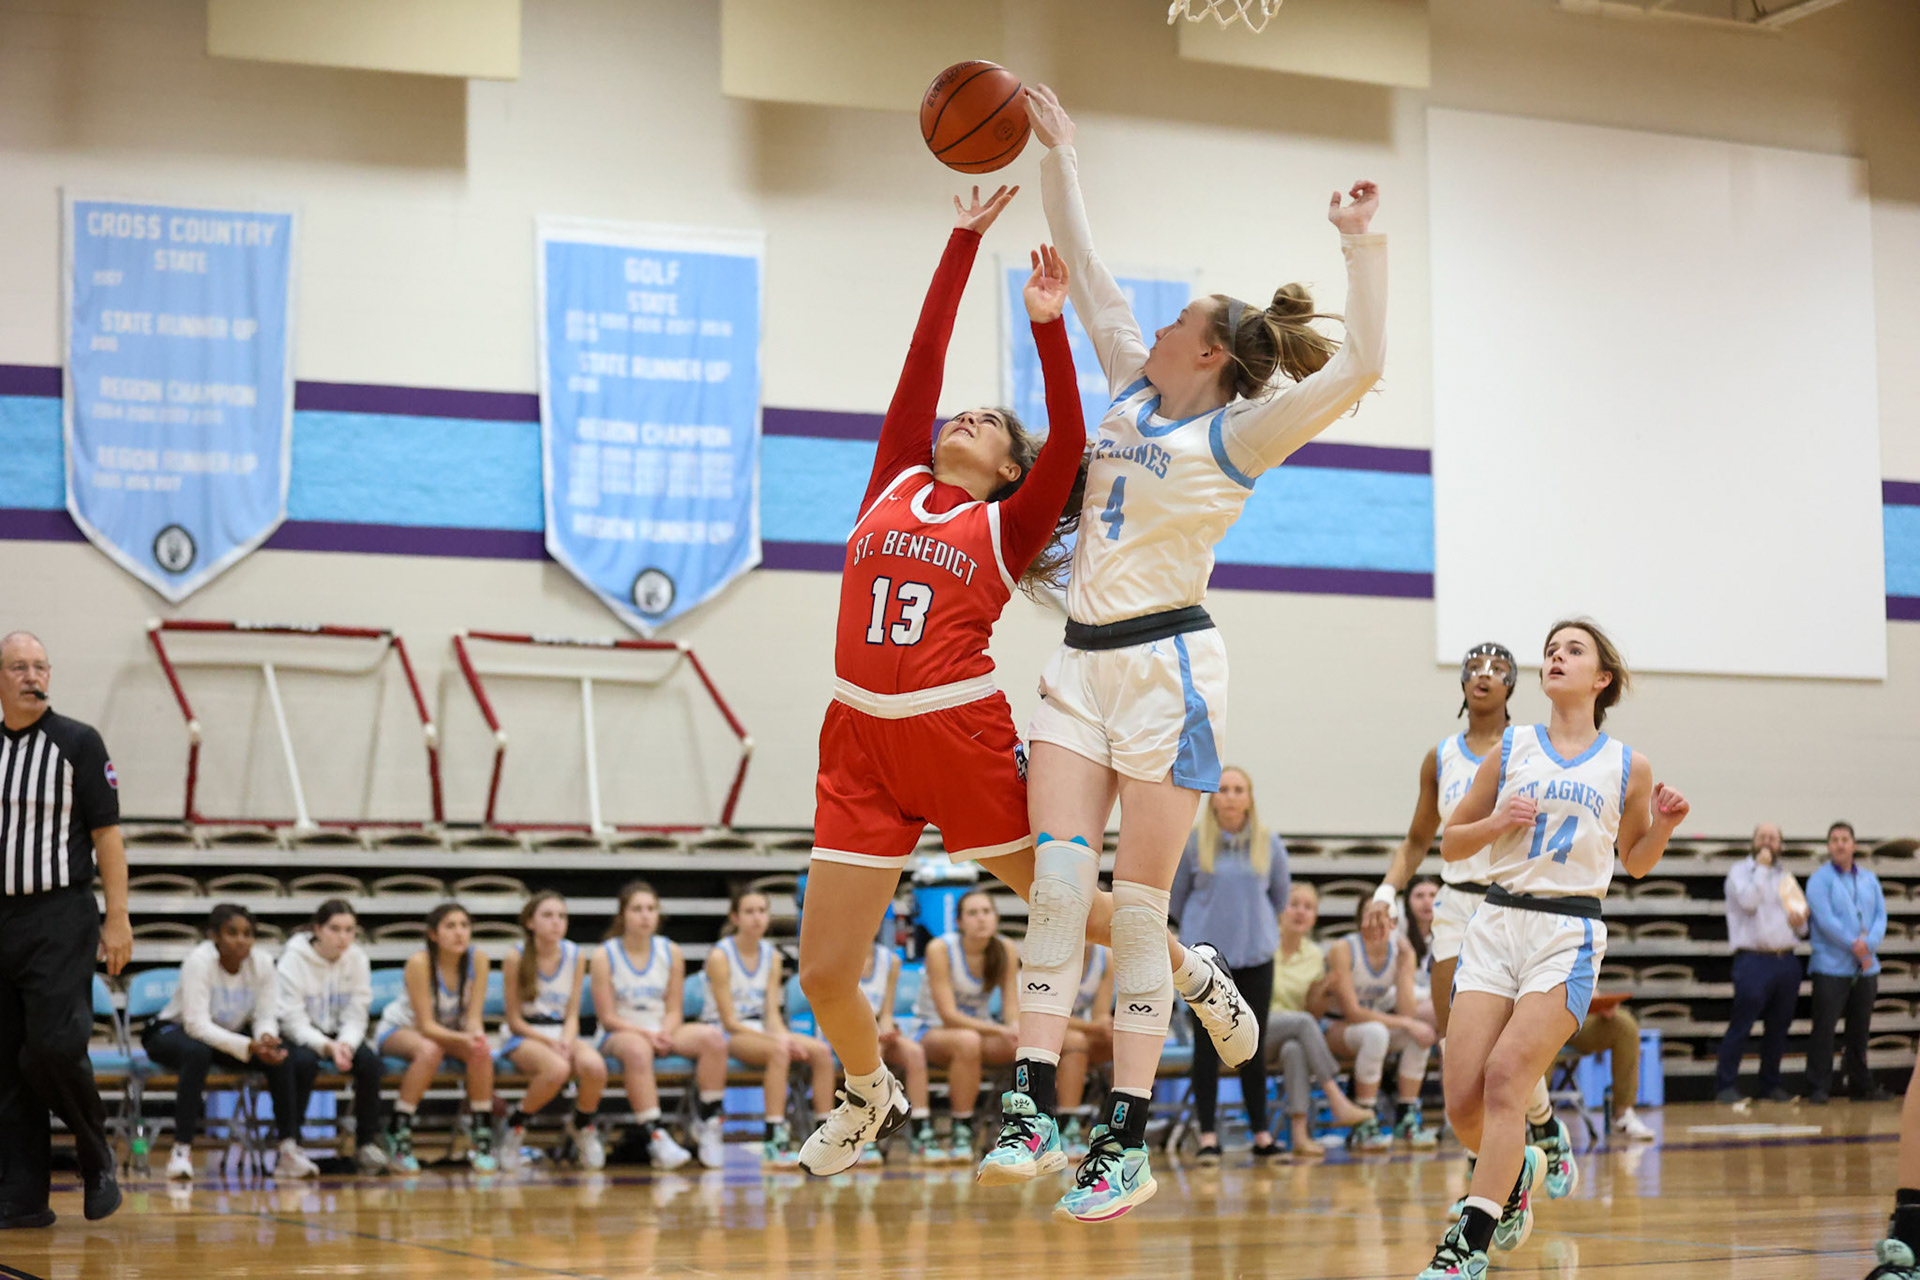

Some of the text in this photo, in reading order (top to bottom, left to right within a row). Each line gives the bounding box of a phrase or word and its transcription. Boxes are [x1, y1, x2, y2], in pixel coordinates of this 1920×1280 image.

[87, 211, 277, 247] CROSS COUNTRY
[153, 249, 208, 274] STATE
[624, 257, 680, 286] GOLF
[626, 290, 678, 317] STATE
[101, 310, 154, 335] STATE
[231, 318, 259, 342] UP
[579, 351, 628, 379] STATE
[704, 361, 732, 384] UP
[1100, 475, 1127, 541] 4
[853, 529, 979, 587] ST. BENEDICT
[865, 574, 935, 647] 13
[1543, 779, 1605, 819] AGNES
[1526, 811, 1580, 866] 14
